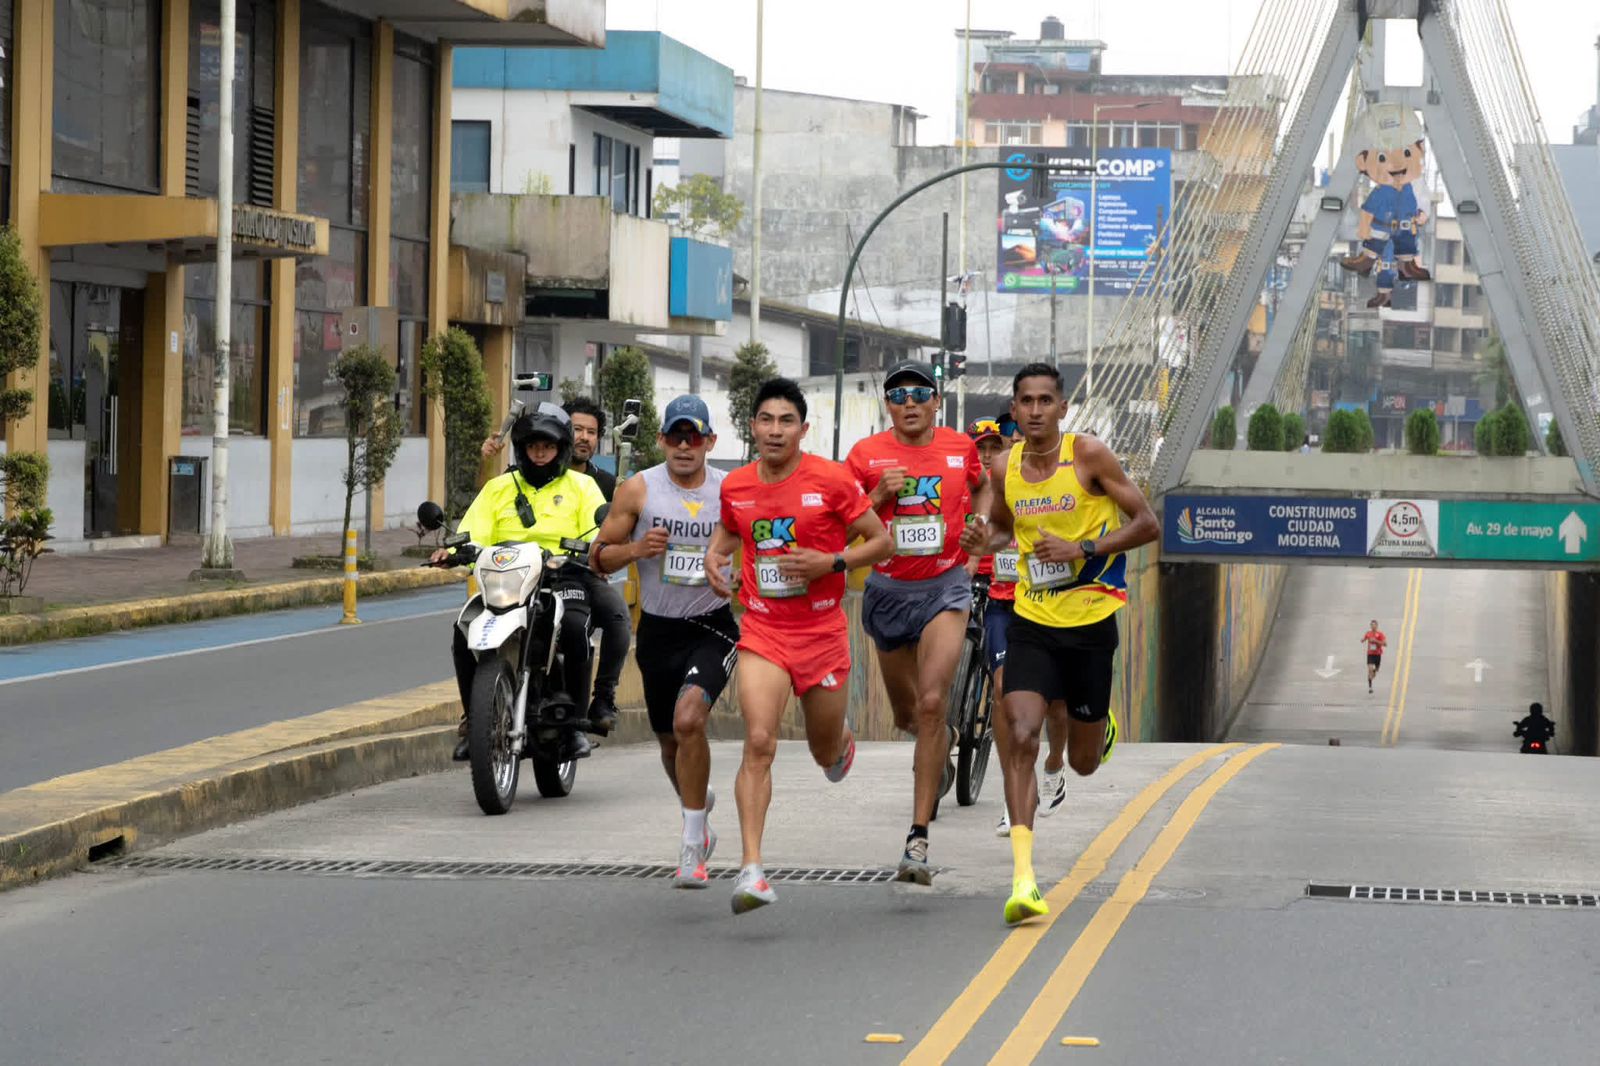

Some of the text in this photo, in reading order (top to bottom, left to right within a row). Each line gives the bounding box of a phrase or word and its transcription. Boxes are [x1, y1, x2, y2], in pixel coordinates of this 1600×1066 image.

[898, 476, 942, 499] 8K
[1015, 496, 1052, 508] ATLETAS
[1196, 506, 1236, 516] ALCALDÍA
[1269, 506, 1357, 519] CONSTRUIMOS
[653, 516, 719, 538] ENRIQU
[1195, 516, 1236, 528] Santo
[1288, 520, 1334, 533] CIUDAD
[752, 516, 796, 543] 8K
[900, 527, 937, 543] 1383
[1194, 528, 1253, 544] Domingo
[1466, 523, 1553, 540] Av. 29 de mayo
[1278, 534, 1341, 548] MODERNA
[669, 556, 704, 571] 1078
[998, 557, 1016, 571] 166
[1032, 561, 1066, 580] 1758
[556, 587, 585, 601] RÁNSITO
